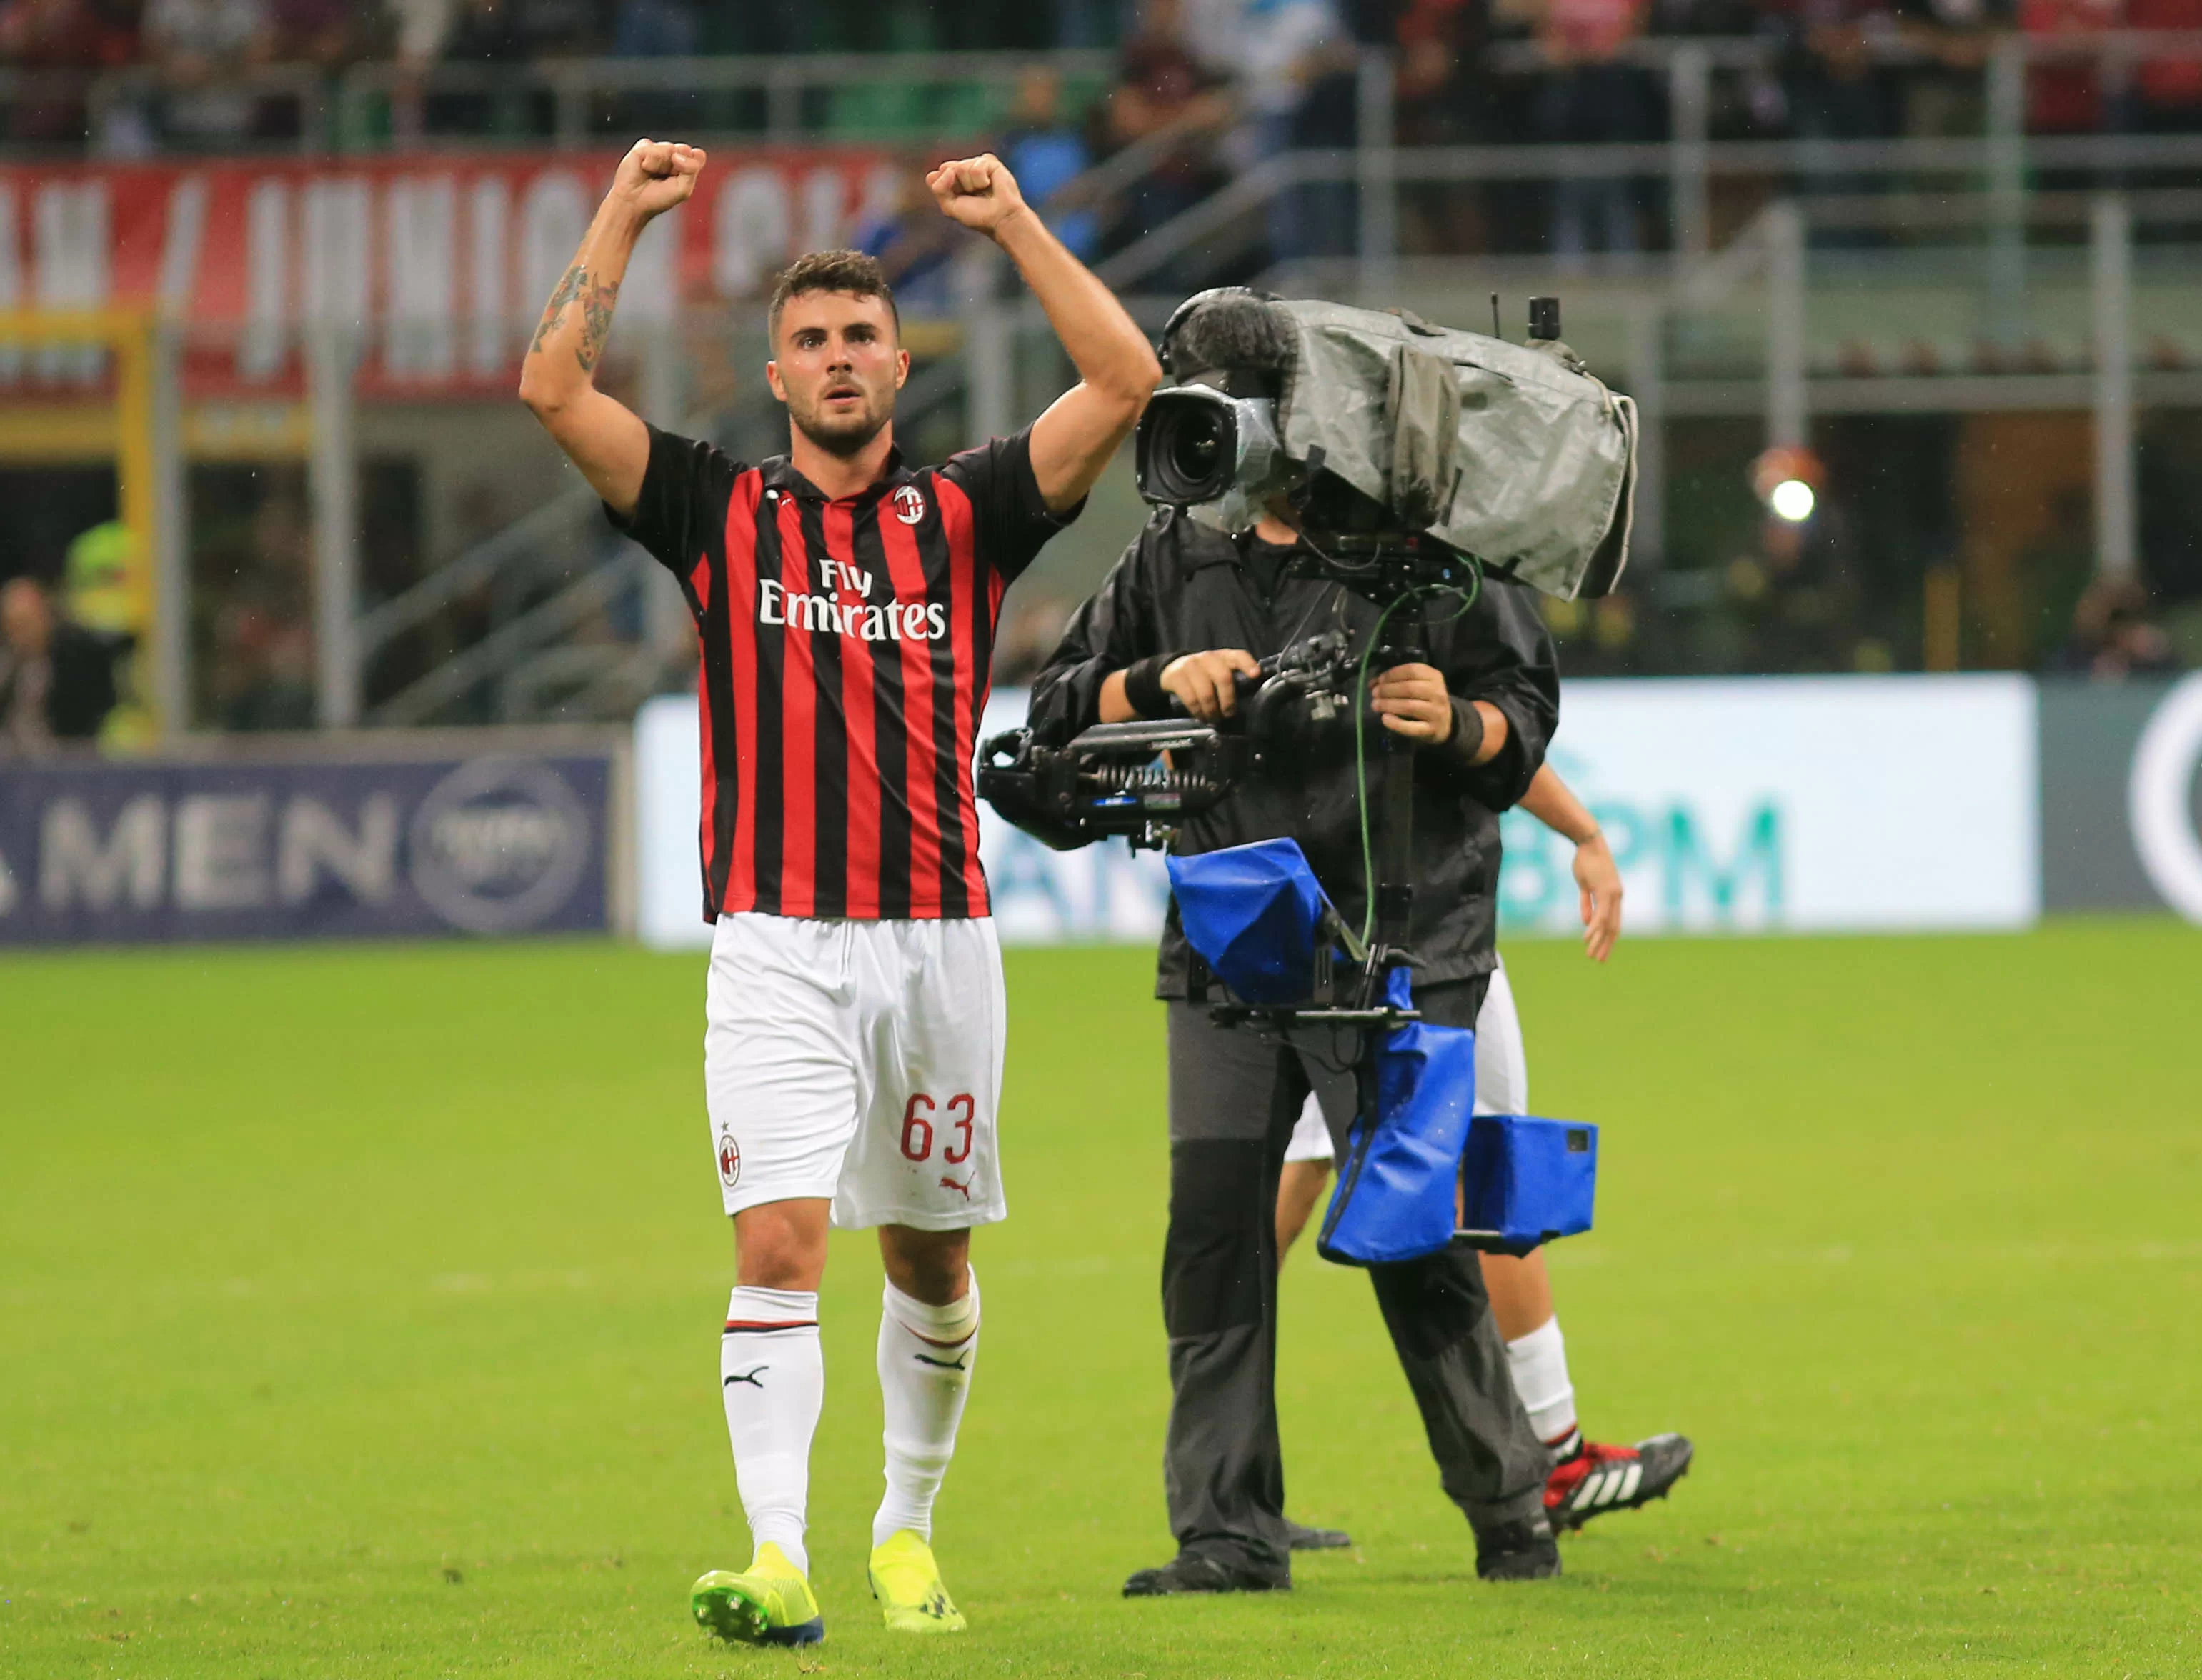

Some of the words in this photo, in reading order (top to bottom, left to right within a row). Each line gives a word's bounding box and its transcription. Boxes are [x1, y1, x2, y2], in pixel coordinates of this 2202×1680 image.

[759, 578, 945, 640] Emirates
[819, 559, 872, 598] Fly
[39, 791, 399, 911] MEN
[900, 1092, 975, 1164] 63
